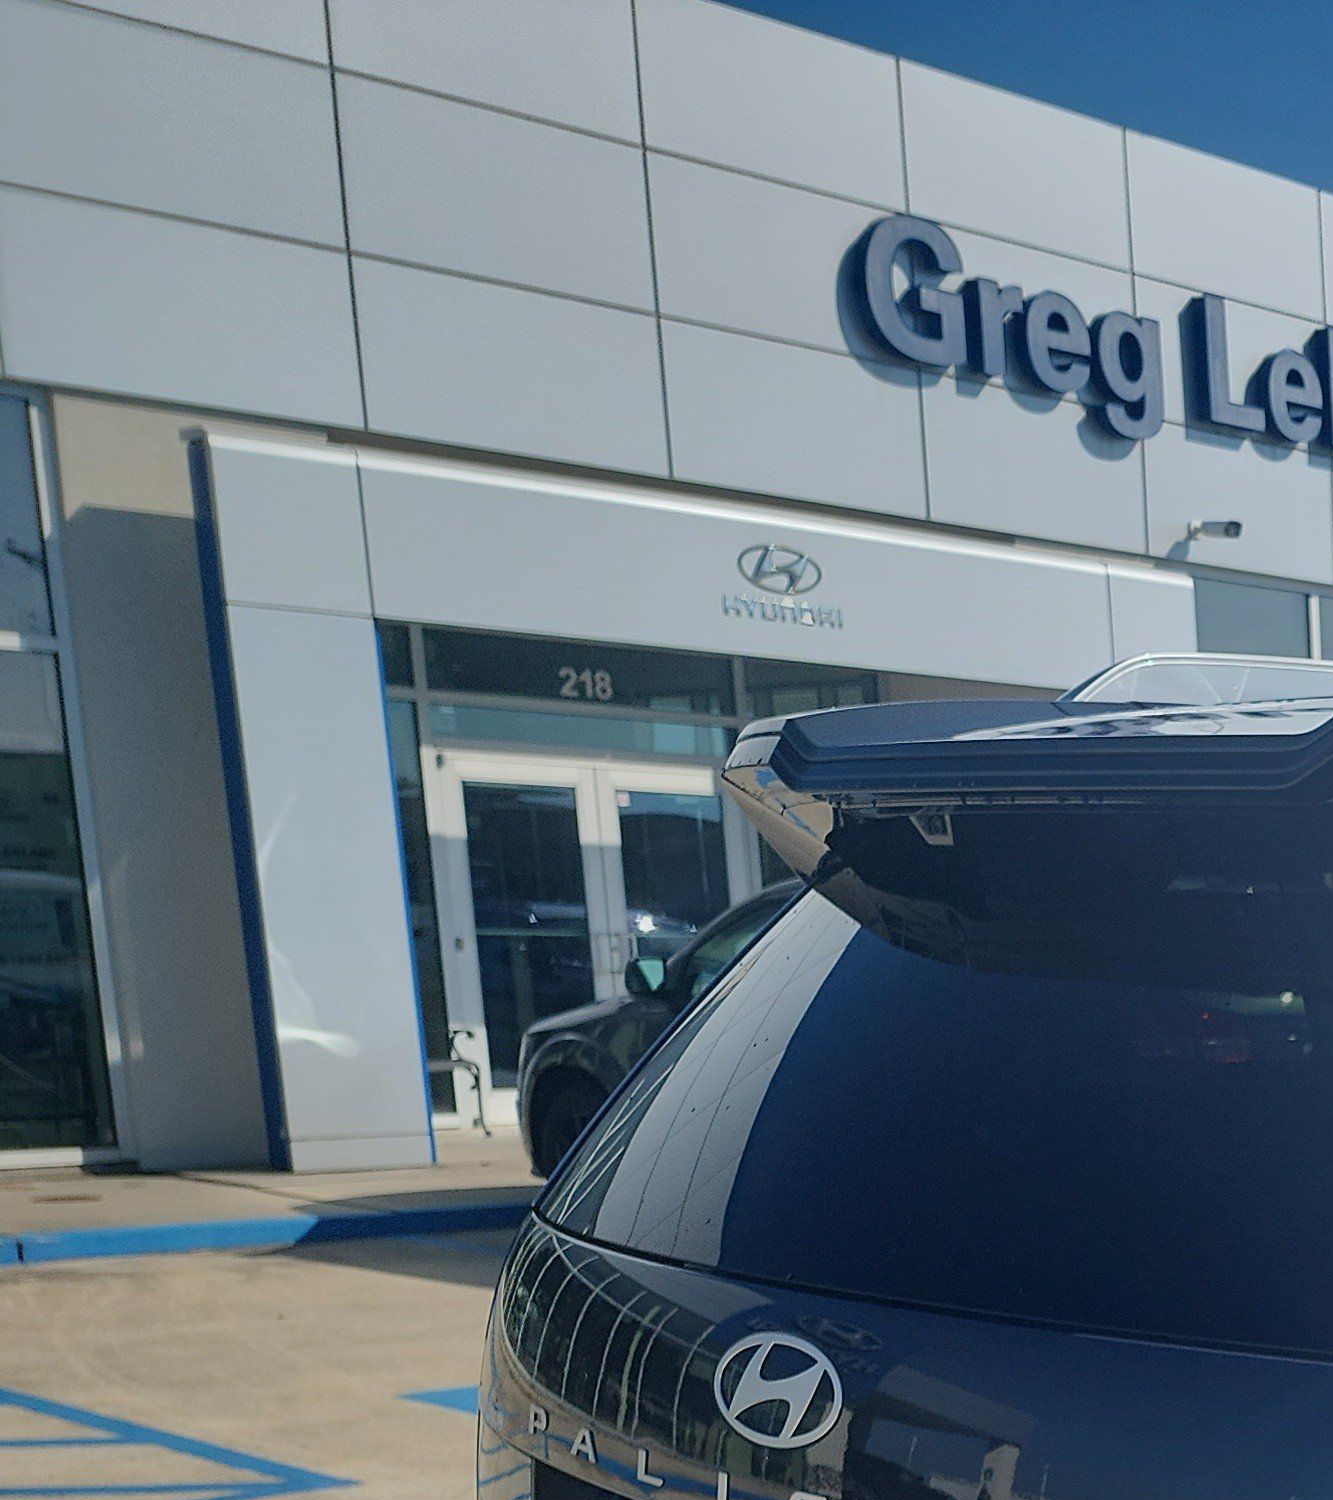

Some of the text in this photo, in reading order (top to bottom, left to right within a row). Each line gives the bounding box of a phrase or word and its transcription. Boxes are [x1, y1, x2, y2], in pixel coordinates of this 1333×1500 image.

[846, 213, 1165, 441] Greg
[720, 593, 845, 631] HYUNDAI
[558, 665, 614, 701] 218
